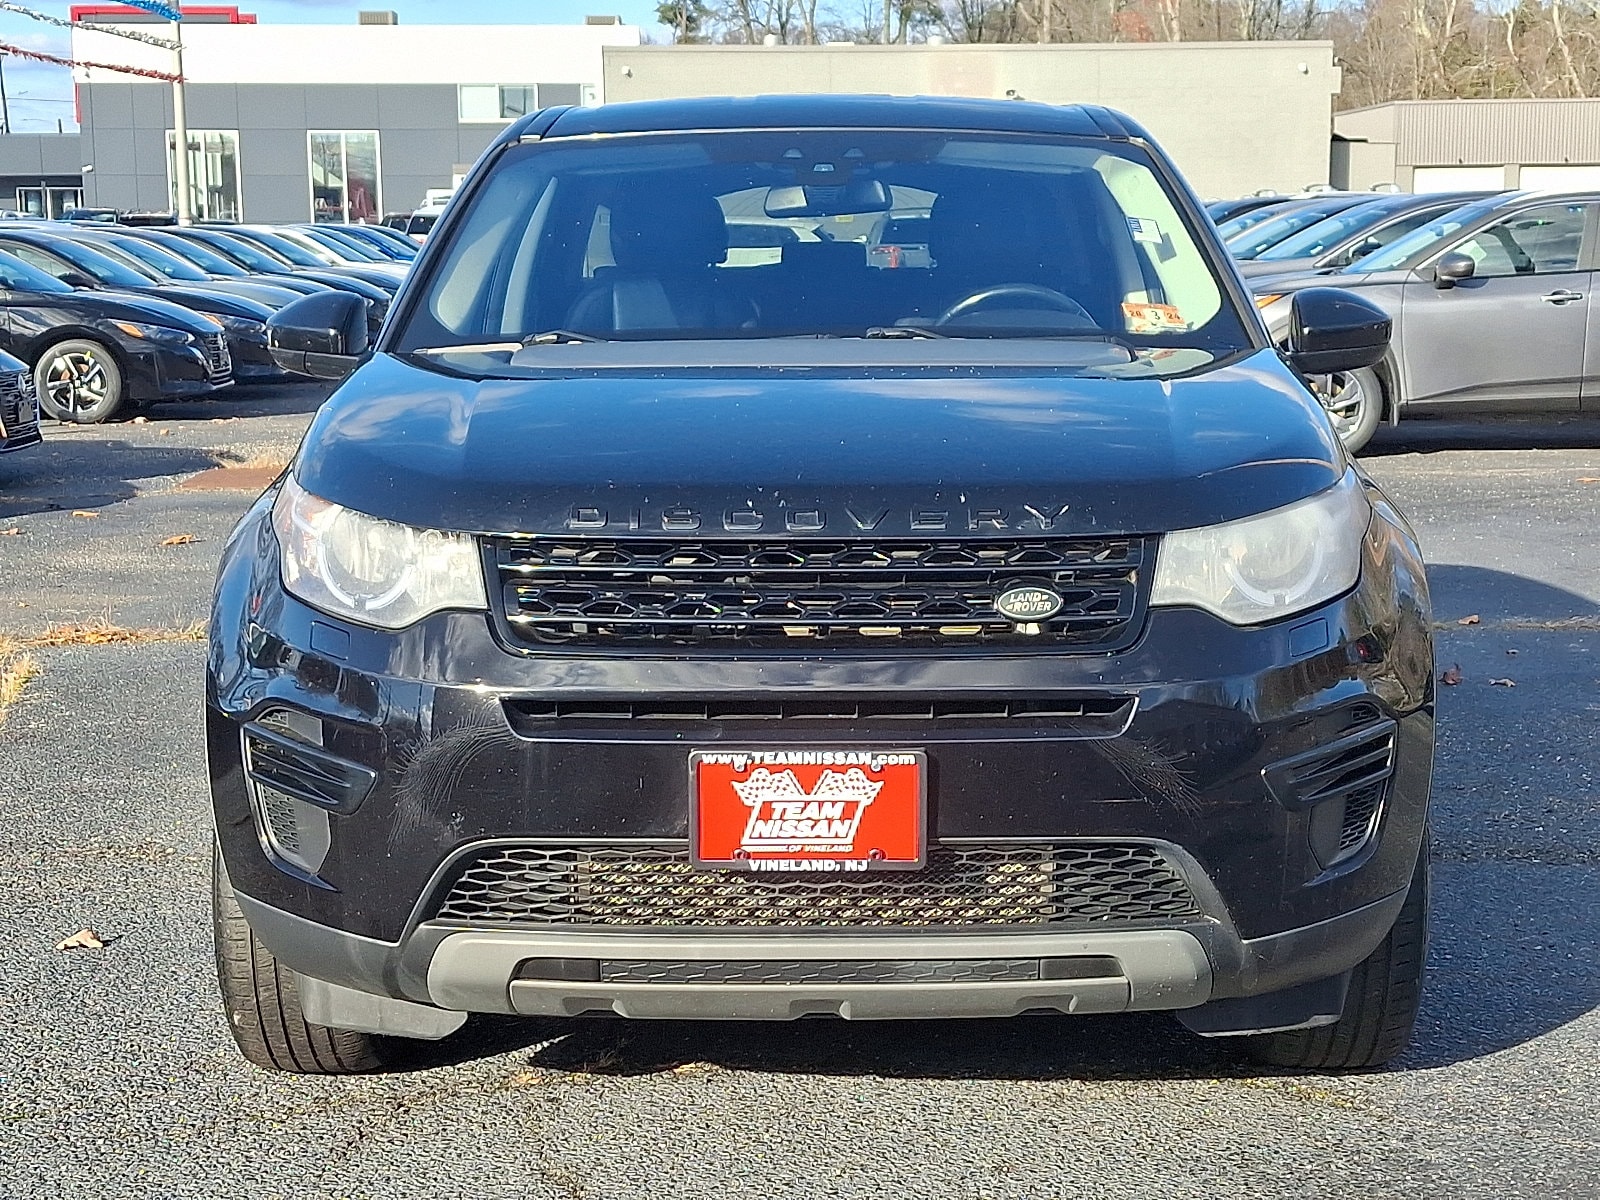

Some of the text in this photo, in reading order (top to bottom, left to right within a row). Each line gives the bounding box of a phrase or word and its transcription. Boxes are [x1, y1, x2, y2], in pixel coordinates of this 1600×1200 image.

[568, 503, 1069, 532] DISCOVERY
[1010, 592, 1041, 603] LAND
[1012, 601, 1052, 612] ROVER
[702, 751, 916, 766] www.TEAMNISSAN.com
[771, 801, 845, 820] TEAM
[750, 819, 852, 838] NISSAN
[788, 844, 854, 853] OF VINELAND
[748, 859, 869, 872] VINELAND, NJ
